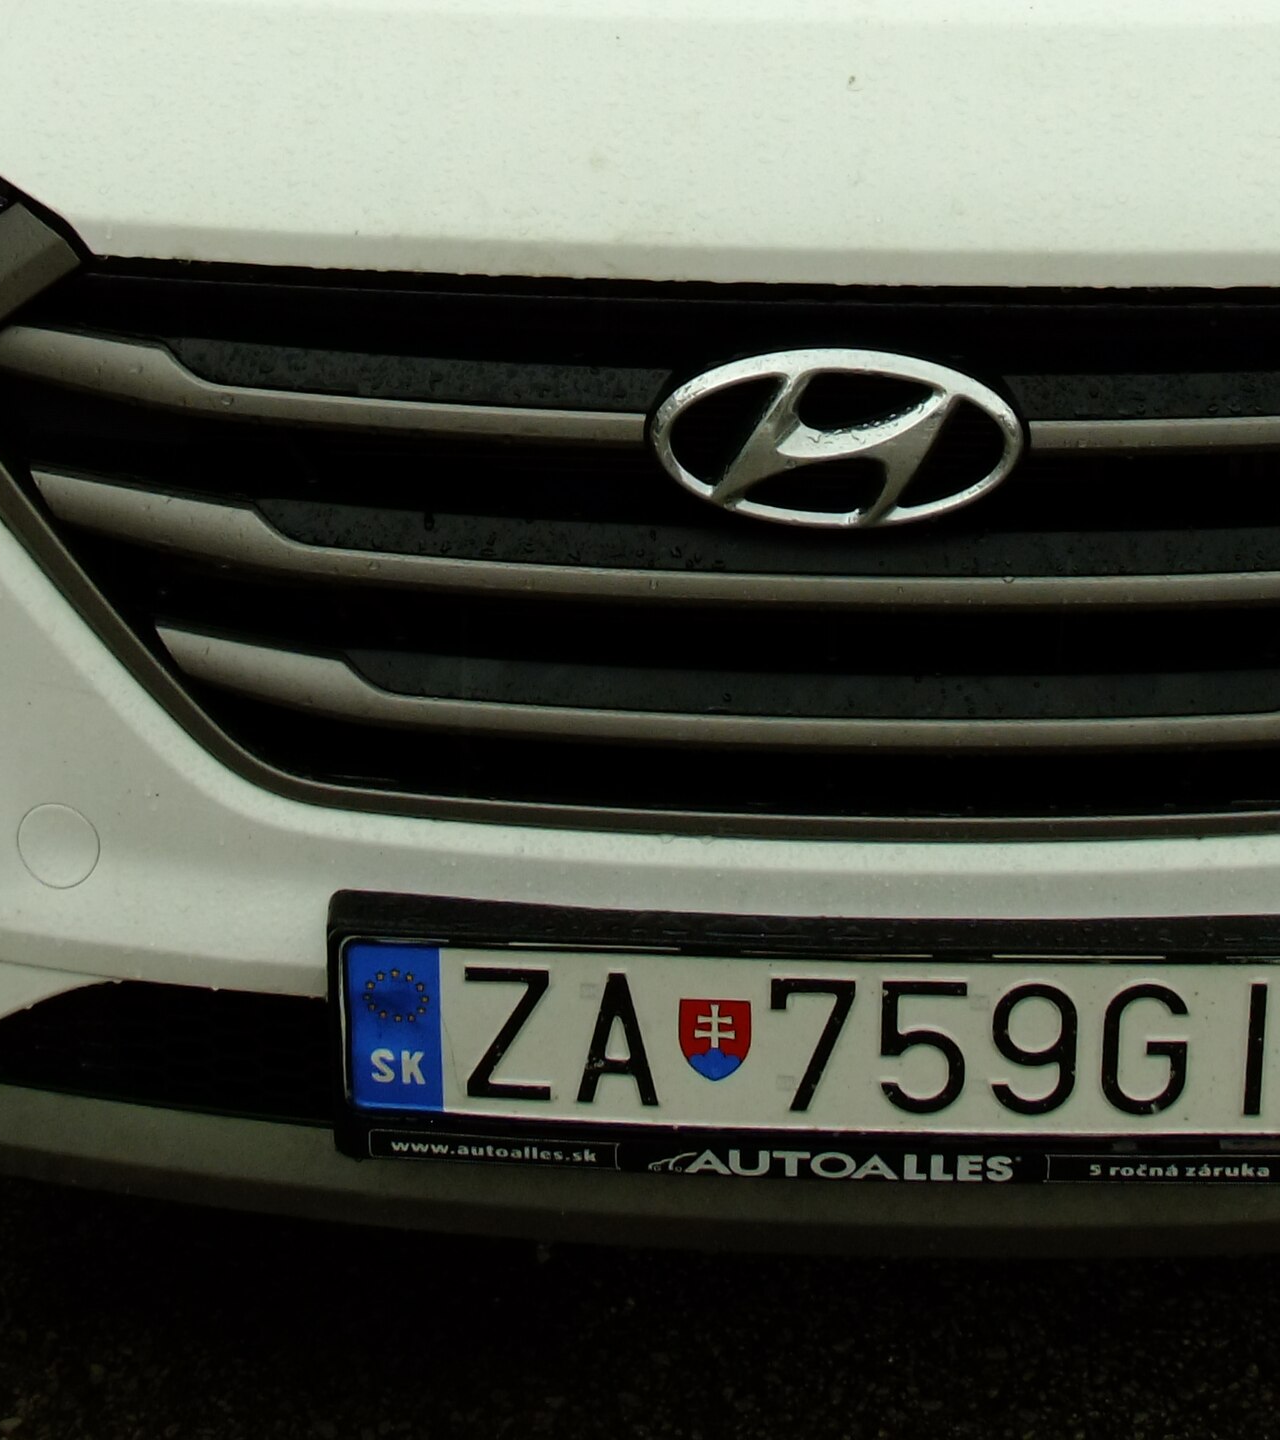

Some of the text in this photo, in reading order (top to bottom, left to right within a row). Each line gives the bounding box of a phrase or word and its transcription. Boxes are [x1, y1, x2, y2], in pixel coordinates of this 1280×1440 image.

[464, 966, 1269, 1116] ZA 759GI
[370, 1048, 426, 1085] SK
[391, 1139, 597, 1162] www.autoalles.sk
[684, 1149, 1014, 1181] AUTOALLES
[1090, 1162, 1270, 1178] 5 ročná záruka
